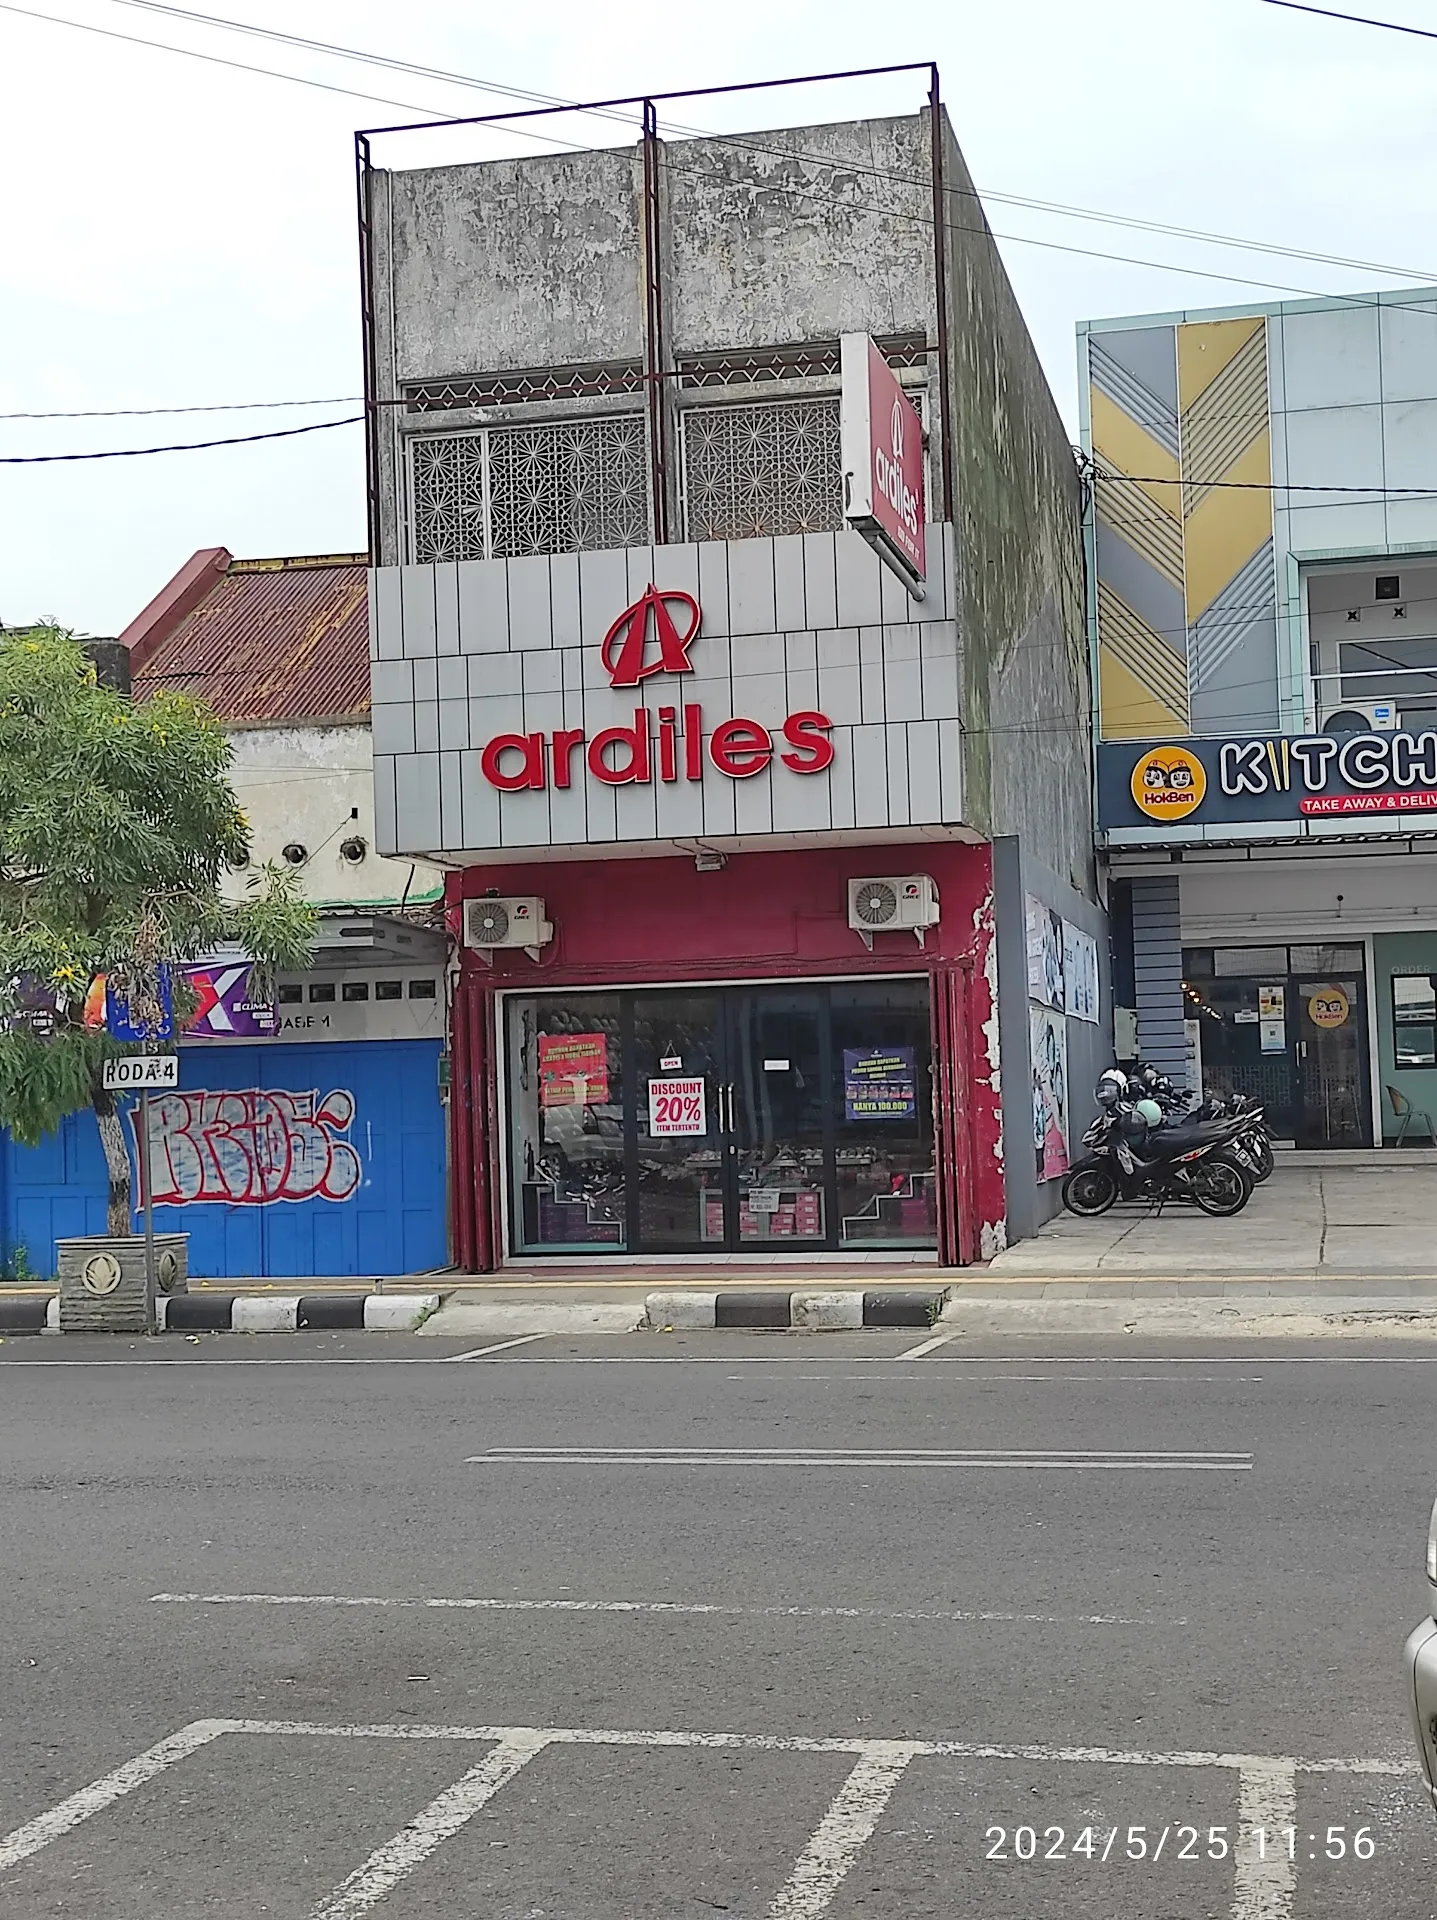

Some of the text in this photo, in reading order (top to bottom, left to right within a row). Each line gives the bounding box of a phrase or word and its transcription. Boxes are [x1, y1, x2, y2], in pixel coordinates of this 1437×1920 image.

[875, 447, 918, 536] ardiles
[480, 703, 836, 792] ardiles
[1143, 792, 1195, 805] HokBen
[1304, 799, 1340, 811] TAKE
[1342, 797, 1384, 809] AWAY
[1386, 796, 1396, 808] &
[1391, 964, 1431, 975] ORDER
[106, 1062, 174, 1083] RODA 4
[651, 1082, 702, 1095] DISCOUNT
[655, 1096, 701, 1122] 20%
[853, 1101, 907, 1110] HANYA 100.000
